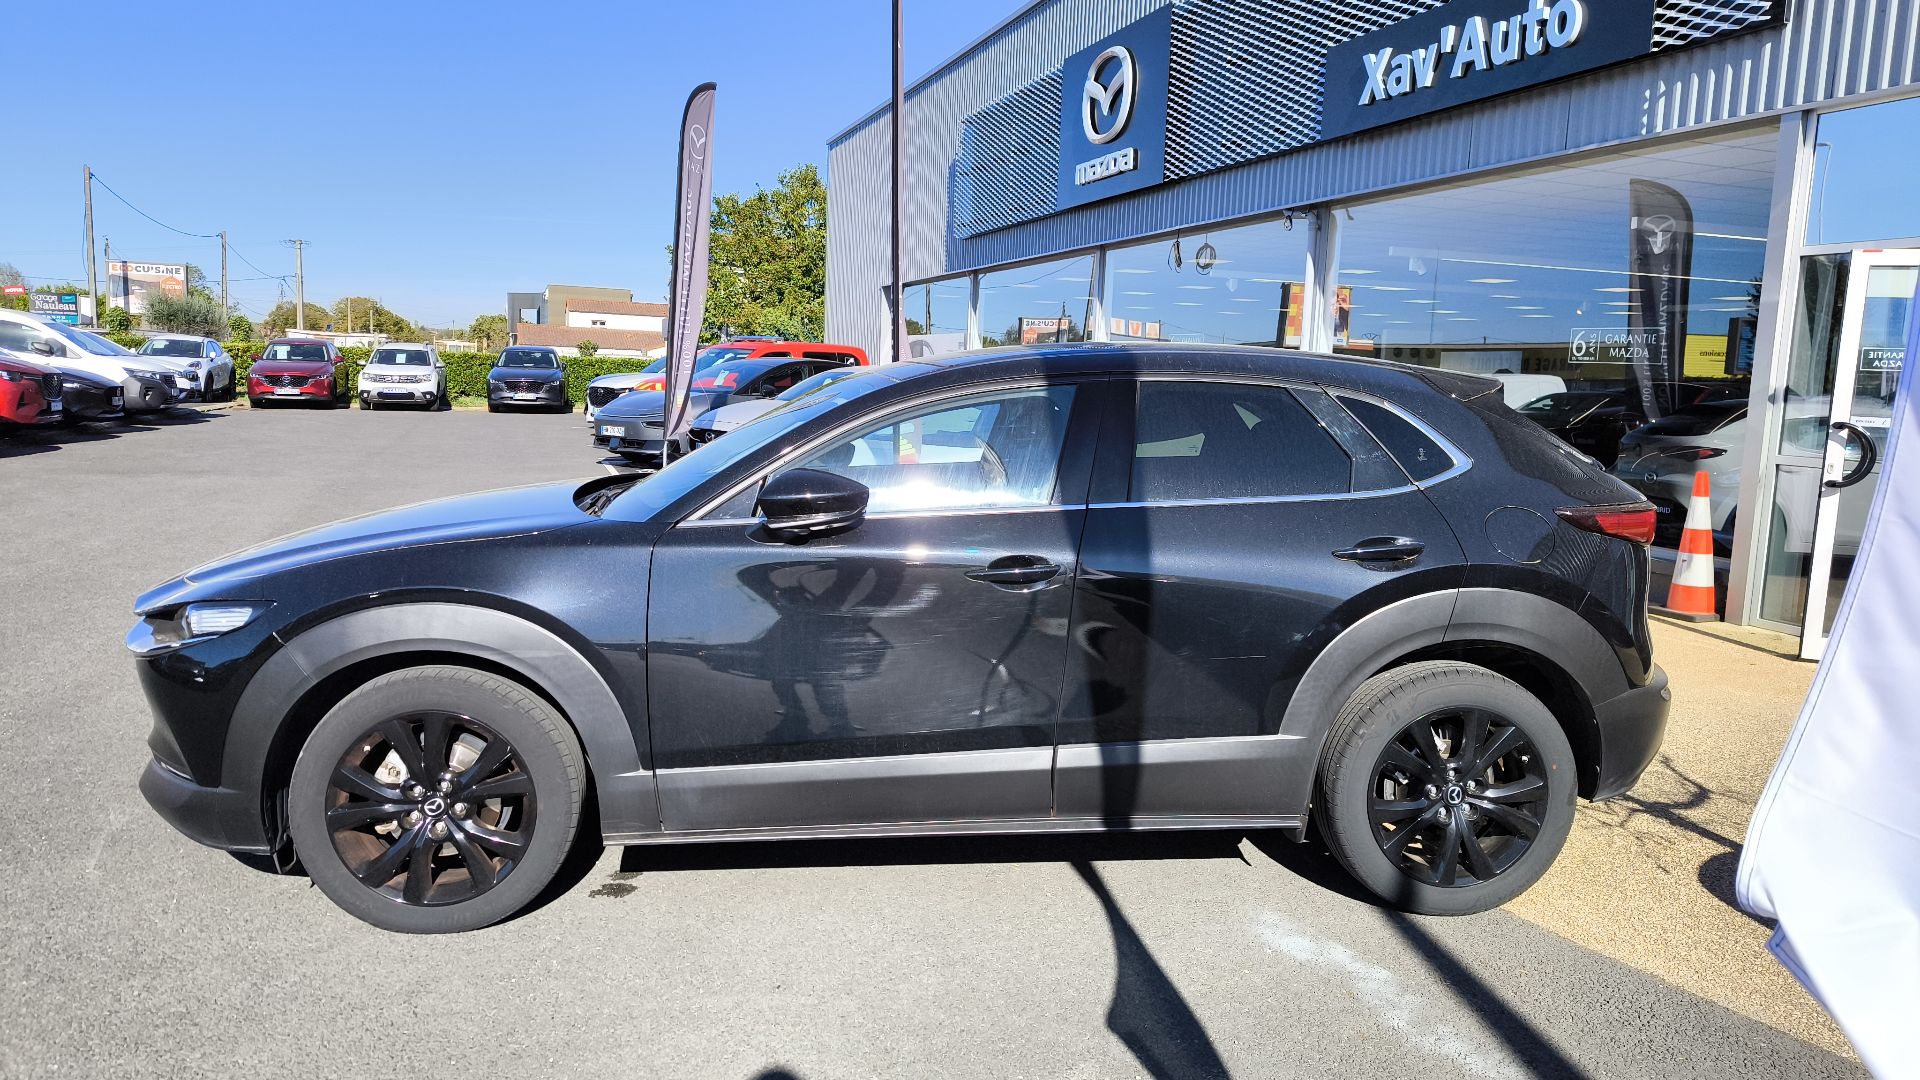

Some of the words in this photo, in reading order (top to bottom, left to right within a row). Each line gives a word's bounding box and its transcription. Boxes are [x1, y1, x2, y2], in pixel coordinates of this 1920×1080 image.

[1358, 0, 1583, 106] Xav'Auto
[34, 300, 77, 311] Nauleau
[1572, 330, 1587, 357] 6
[1589, 333, 1597, 354] ANS
[1605, 333, 1657, 345] GARANTIE
[1609, 347, 1650, 358] MAZDA
